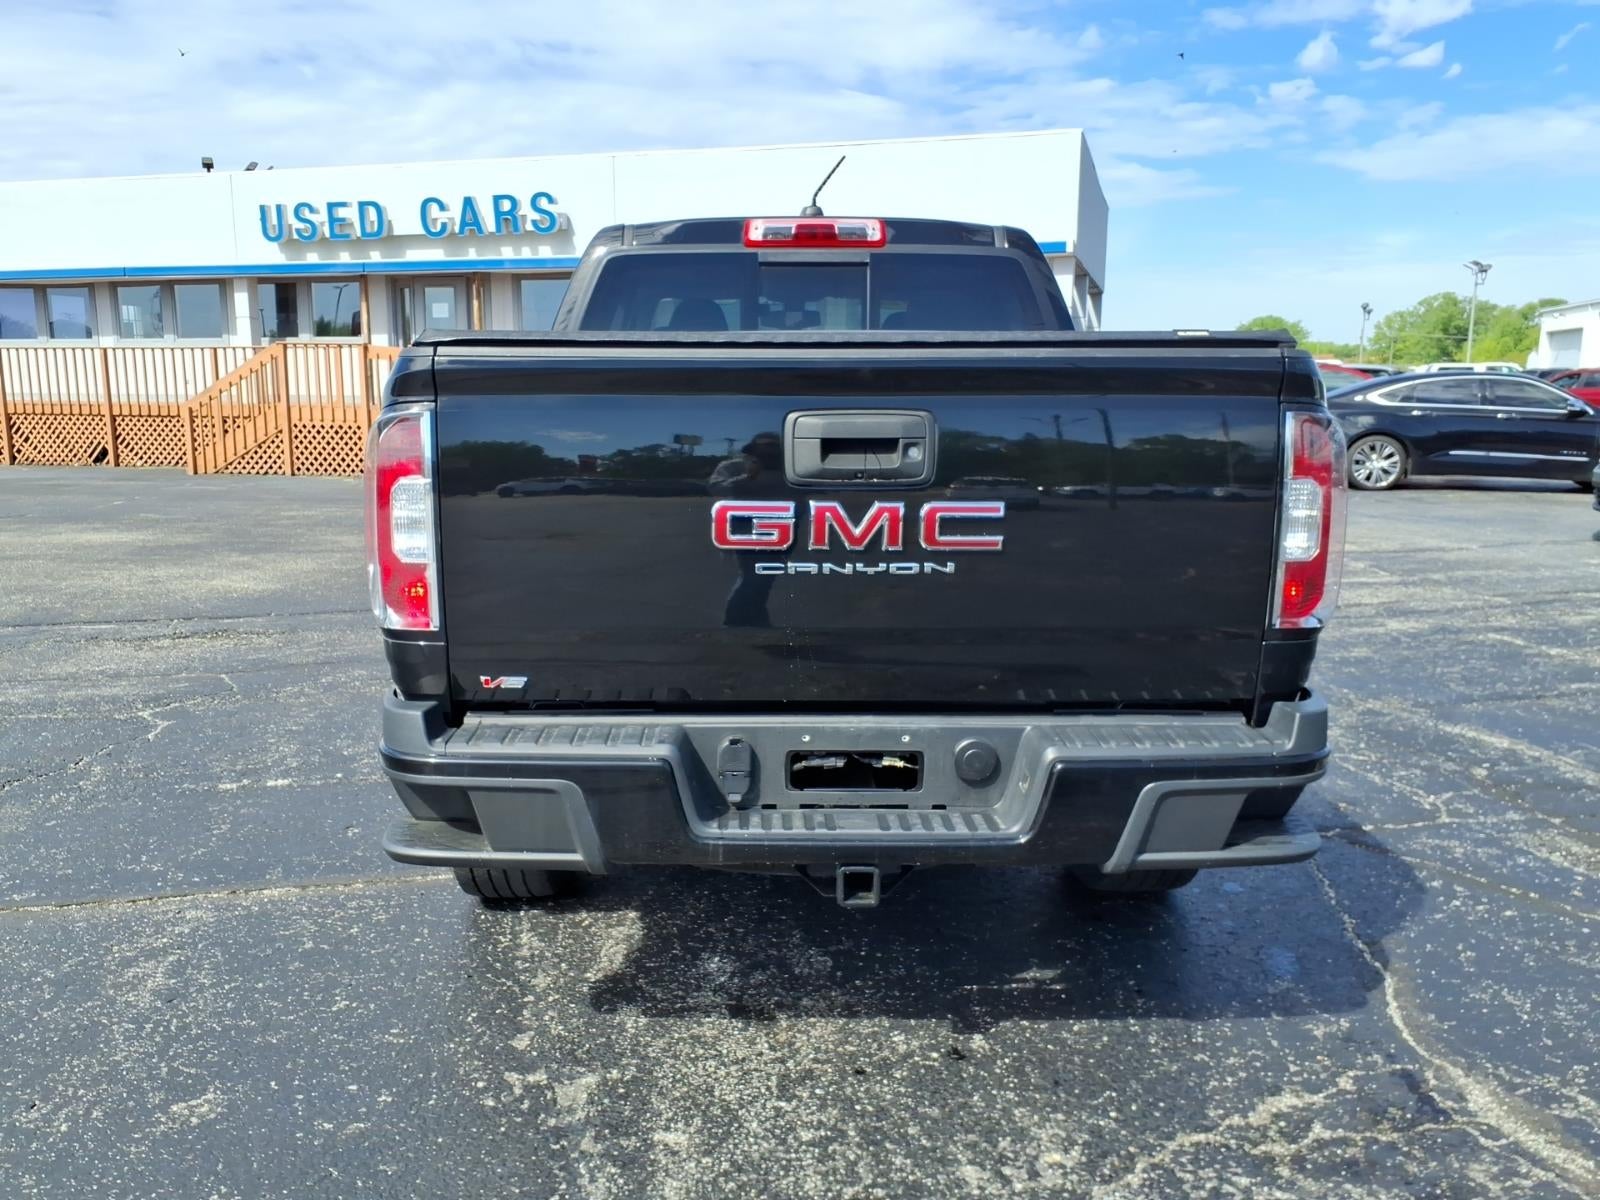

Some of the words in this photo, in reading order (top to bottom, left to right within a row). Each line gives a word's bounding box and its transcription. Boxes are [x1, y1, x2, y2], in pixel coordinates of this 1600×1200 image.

[259, 200, 388, 243] USED
[420, 191, 560, 239] CARS
[711, 500, 1005, 551] GMC
[754, 561, 956, 576] CANYON
[479, 675, 528, 688] V6
